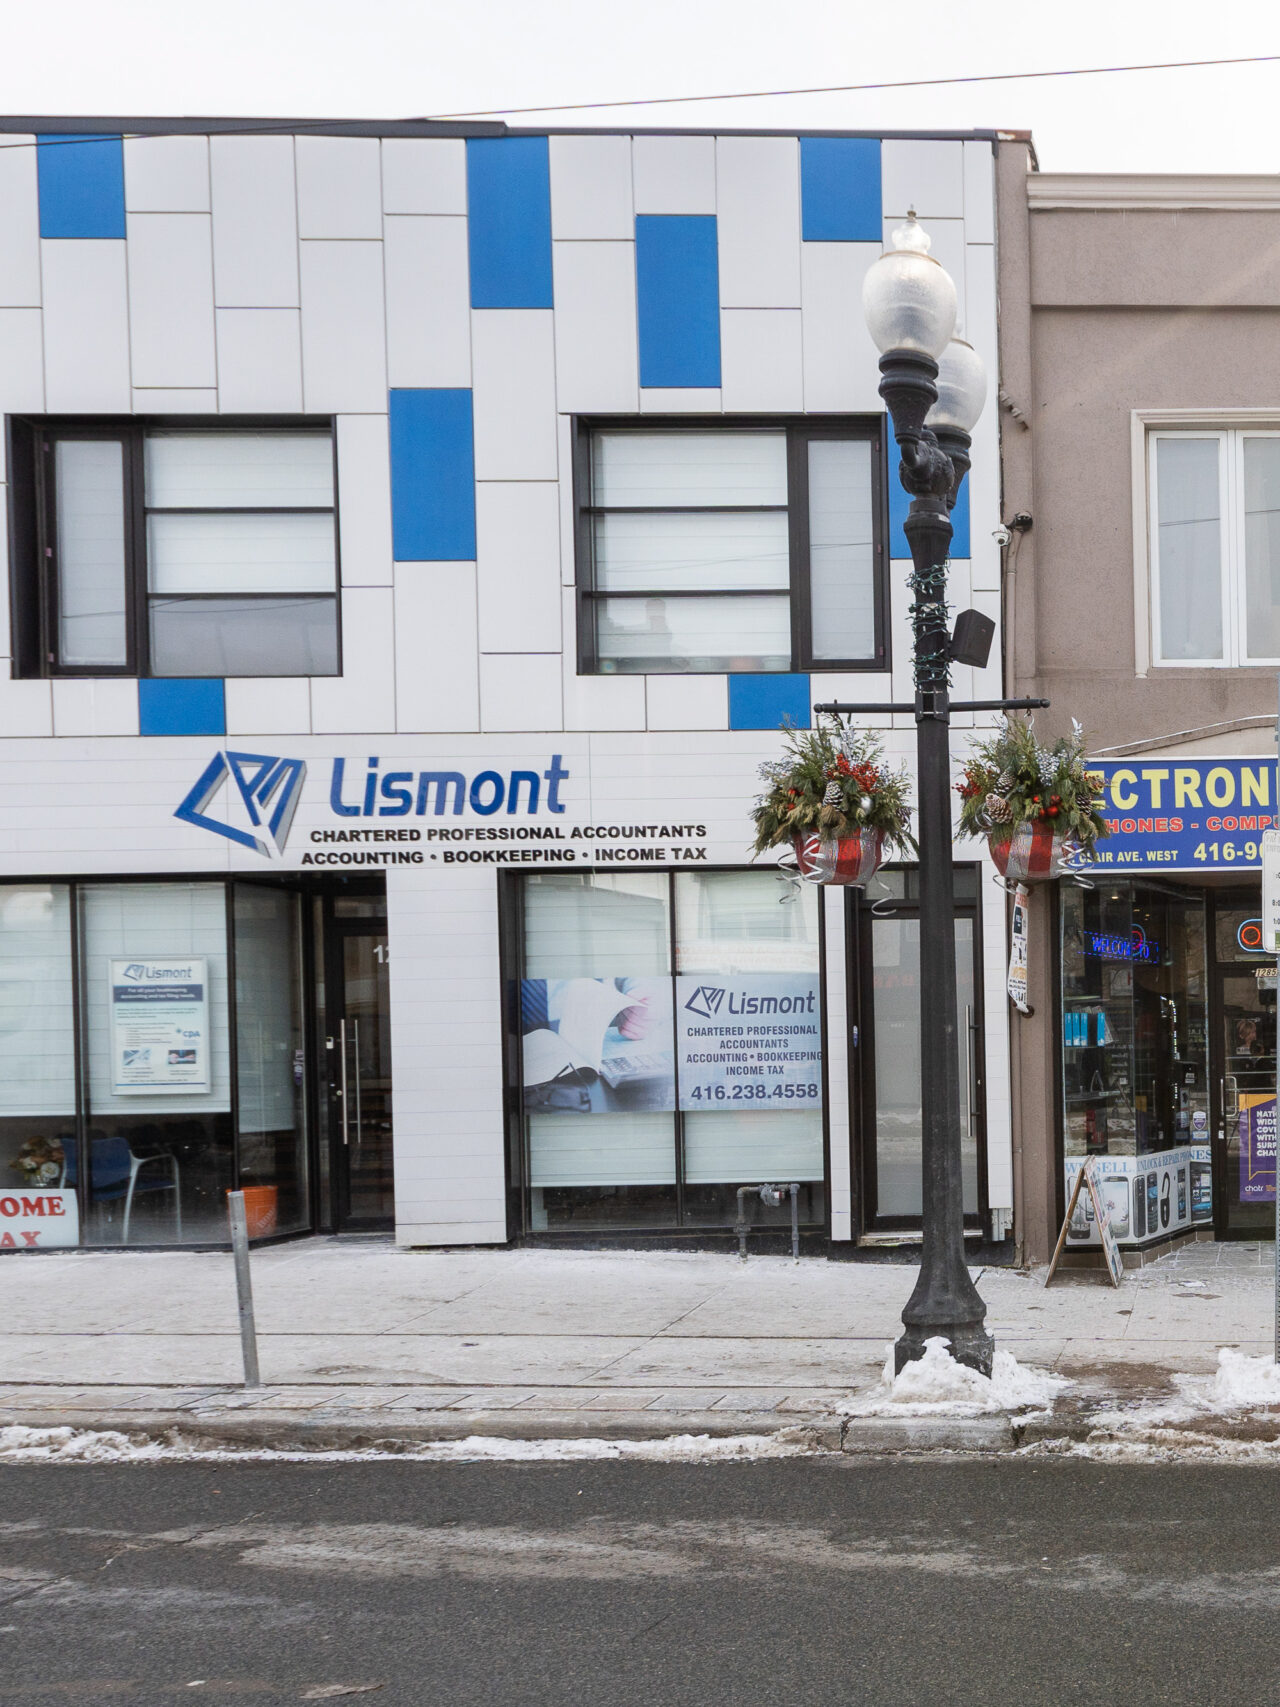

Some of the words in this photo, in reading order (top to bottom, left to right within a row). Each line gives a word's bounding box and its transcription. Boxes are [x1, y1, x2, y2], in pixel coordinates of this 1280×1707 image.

[330, 754, 569, 817] Lismont
[1084, 766, 1280, 810] ECTRON
[310, 828, 421, 843] CHARTERED
[427, 826, 565, 842] PROFESSIONAL
[571, 824, 707, 840] ACCOUNTANTS
[1105, 818, 1183, 834] HONES
[301, 850, 424, 866] ACCOUNTING
[443, 848, 576, 864] BOOKKEEPING
[595, 848, 666, 862] INCOME
[672, 847, 708, 861] TAX
[1117, 851, 1143, 862] AVE.
[1146, 850, 1178, 862] WEST
[145, 966, 192, 979] Lismont
[728, 990, 816, 1015] Lismont
[687, 1026, 744, 1037] CHARTERED
[747, 1025, 818, 1036] PROFESSIONAL
[719, 1038, 789, 1049] ACCOUNTANTS
[686, 1053, 748, 1064] ACCOUNTING
[757, 1051, 823, 1062] BOOKKEEPING
[726, 1065, 764, 1076] INCOME
[767, 1065, 785, 1075] TAX
[691, 1083, 819, 1101] 416.238.4558
